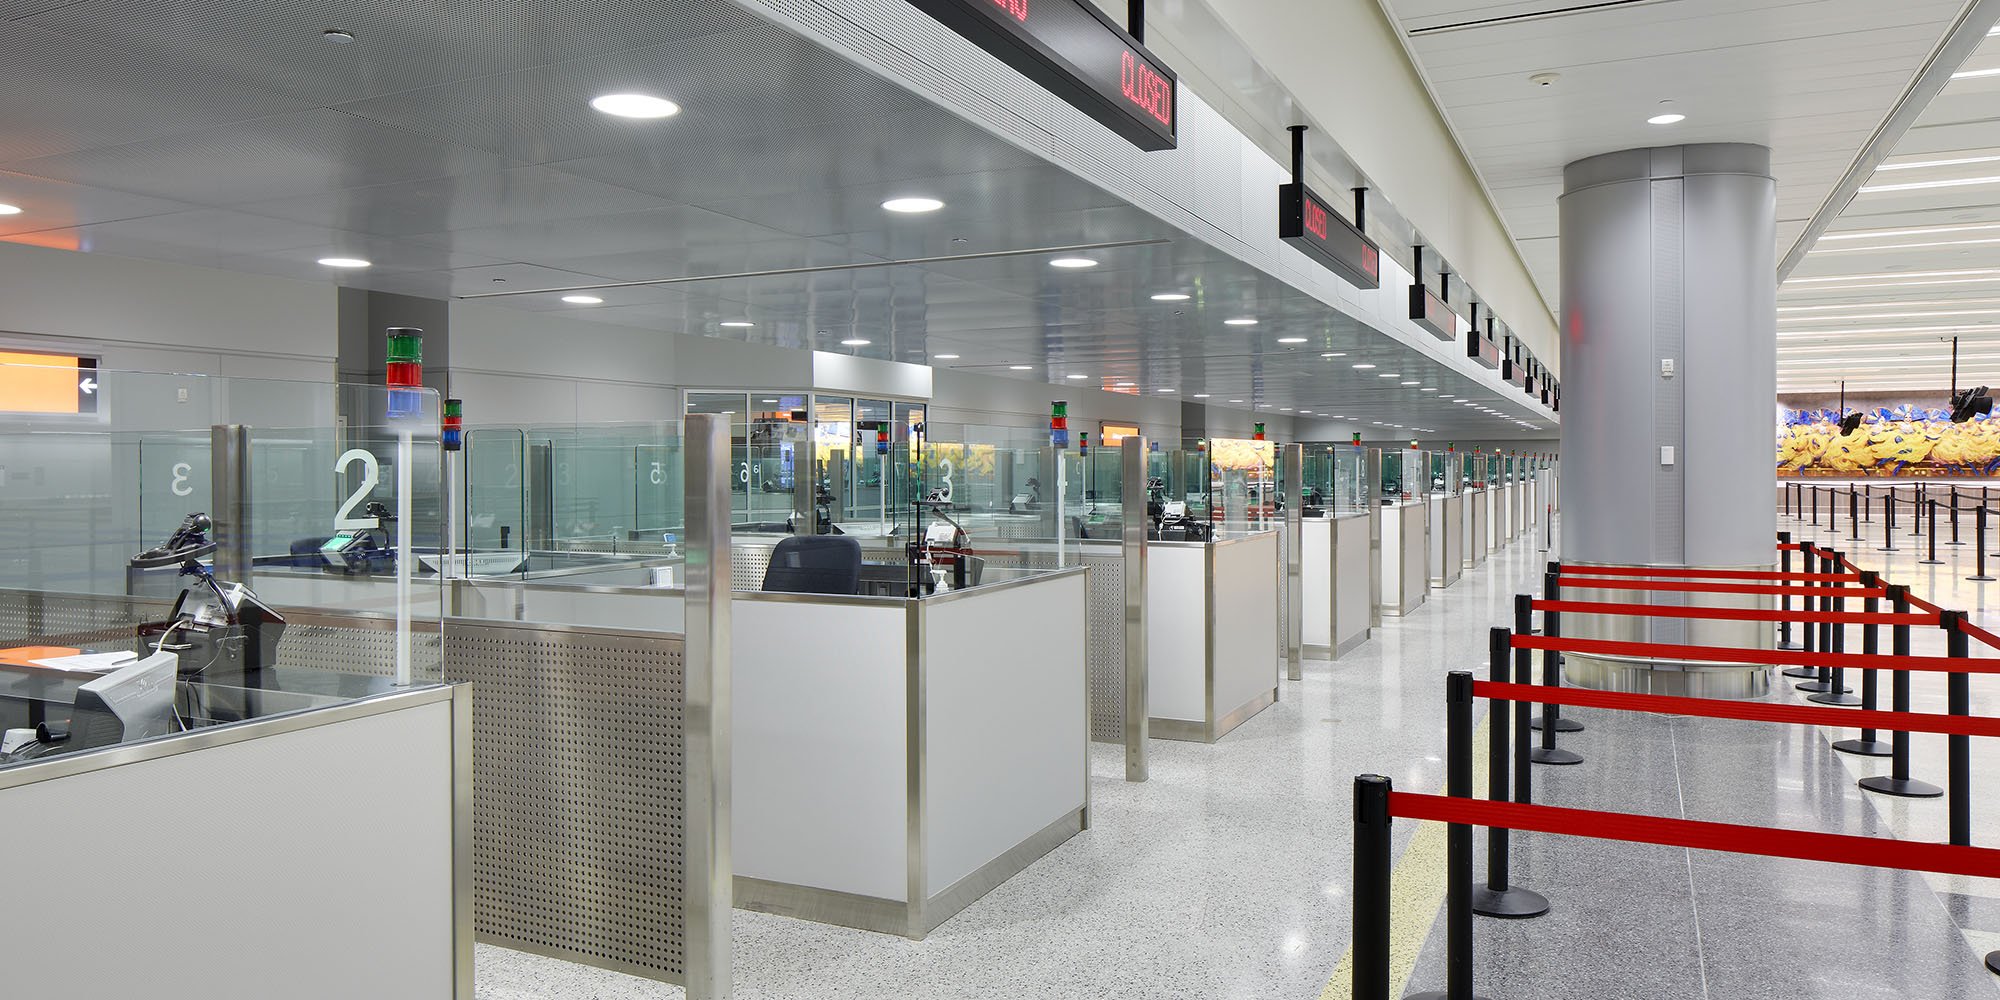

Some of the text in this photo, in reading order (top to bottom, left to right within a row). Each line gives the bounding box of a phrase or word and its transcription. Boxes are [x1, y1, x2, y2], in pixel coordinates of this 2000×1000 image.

[1121, 50, 1170, 126] CLOSED
[1305, 198, 1326, 241] CLOSED
[334, 449, 379, 531] 2
[939, 458, 953, 503] 3
